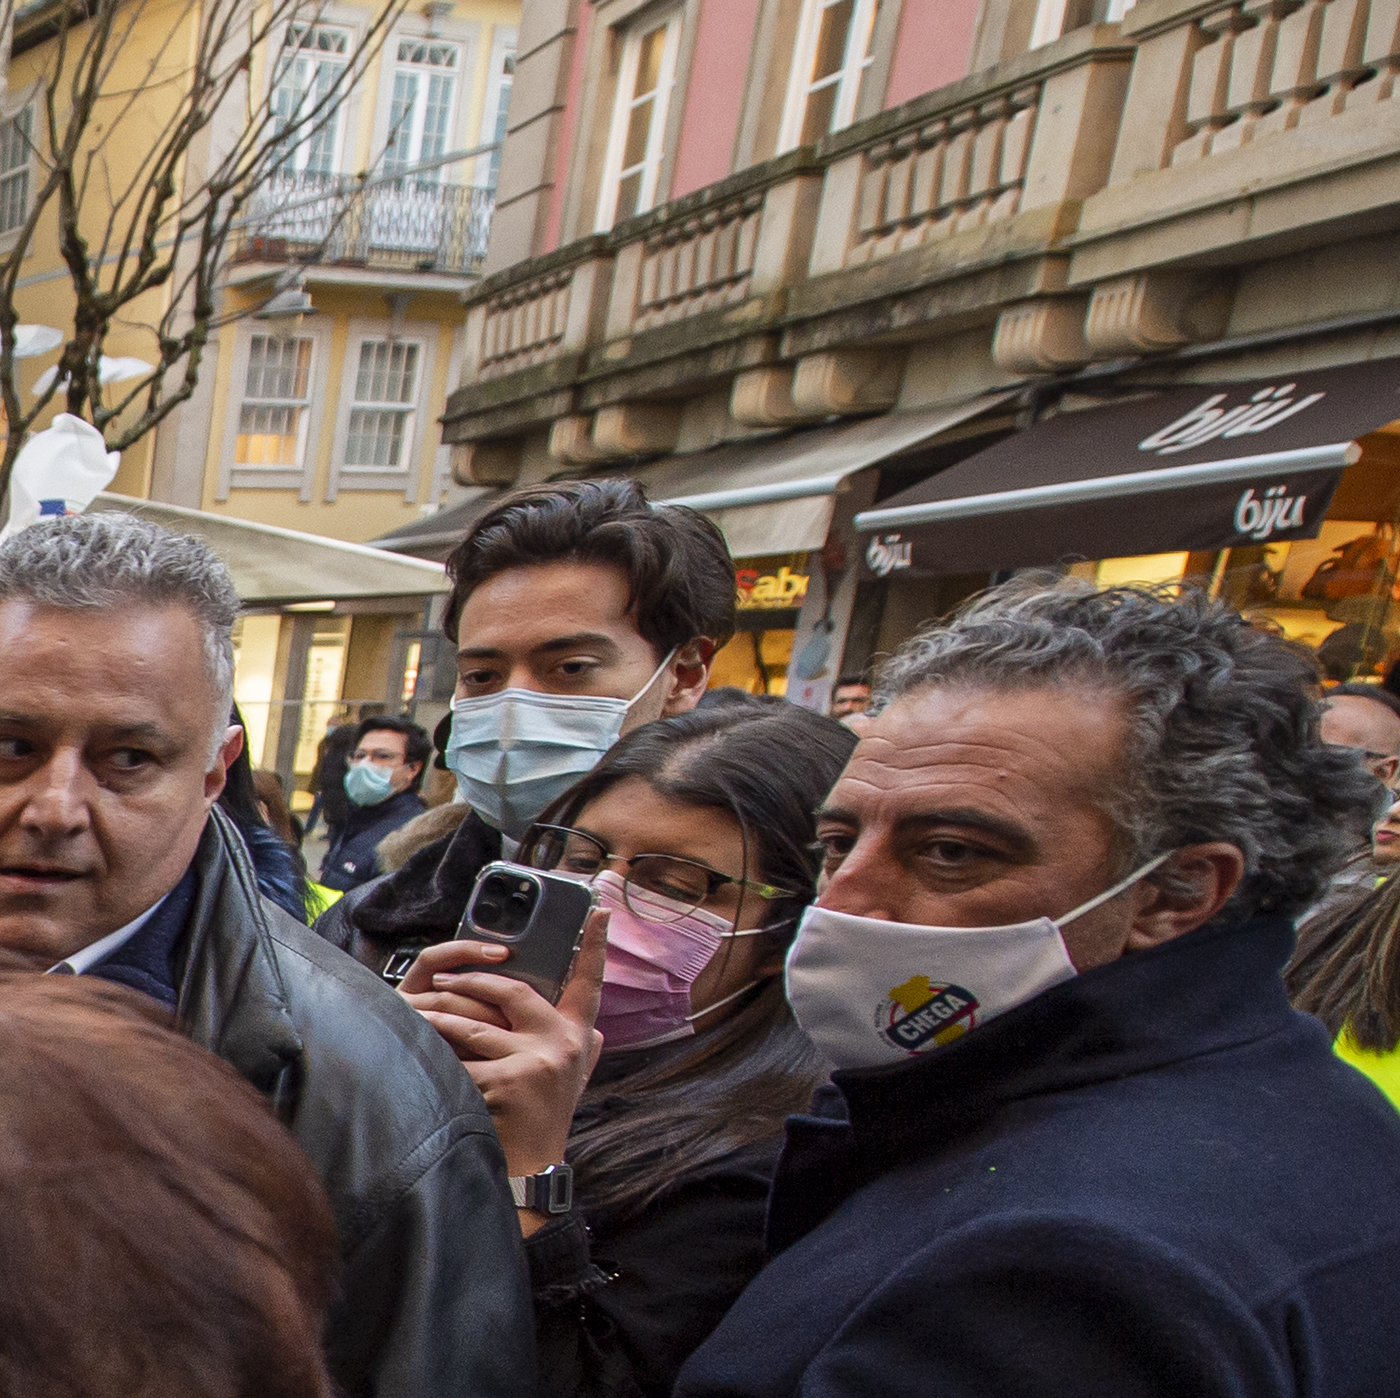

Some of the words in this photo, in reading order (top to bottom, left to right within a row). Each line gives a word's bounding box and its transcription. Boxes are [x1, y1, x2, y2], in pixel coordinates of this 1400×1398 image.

[1138, 383, 1327, 456] biju
[1233, 485, 1307, 540] biju
[897, 993, 969, 1041] CHEGA
